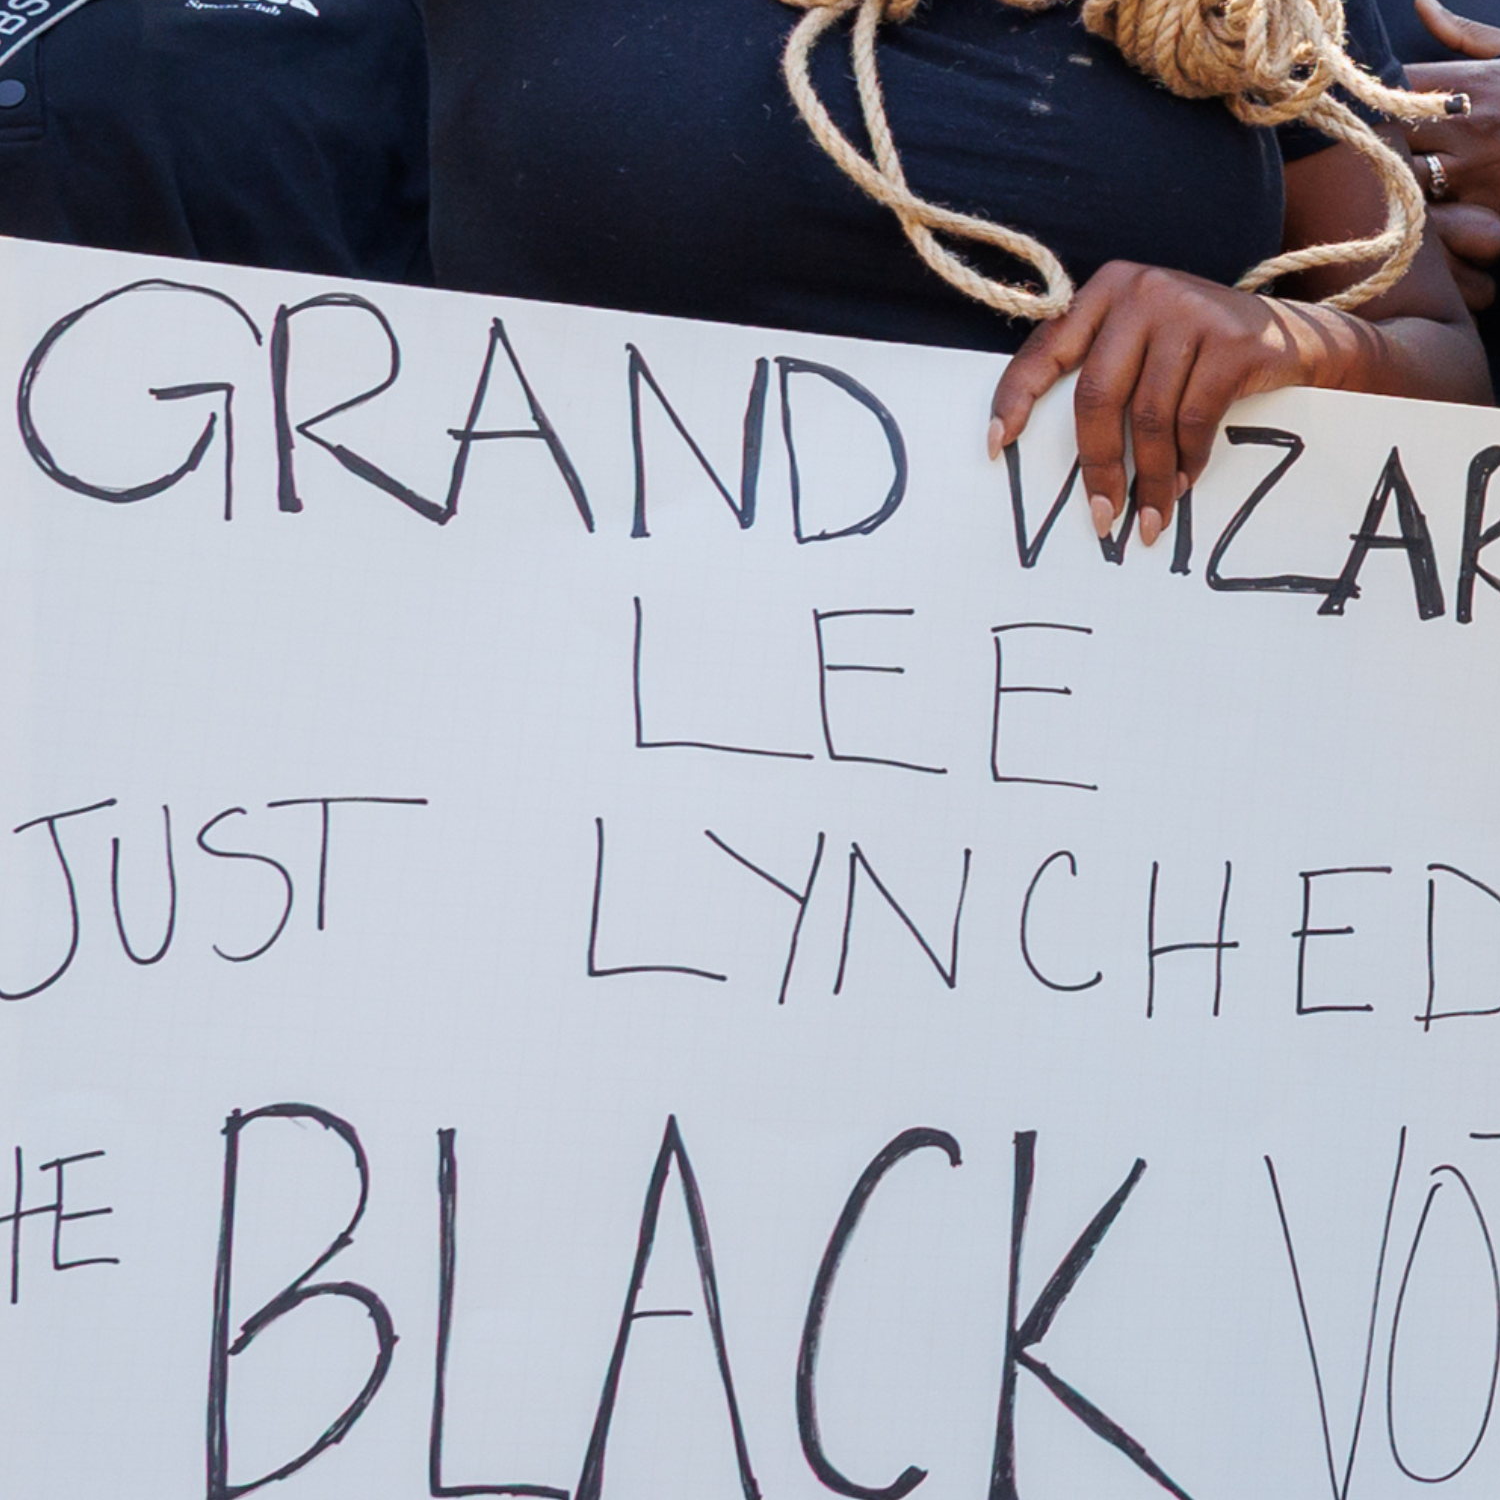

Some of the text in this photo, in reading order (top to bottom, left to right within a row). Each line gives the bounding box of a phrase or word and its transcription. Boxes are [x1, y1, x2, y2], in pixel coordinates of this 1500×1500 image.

[17, 278, 908, 545] GRAND
[633, 596, 1098, 791] LEE
[0, 797, 428, 1001] JUST
[206, 1103, 1193, 1500] BLACK
